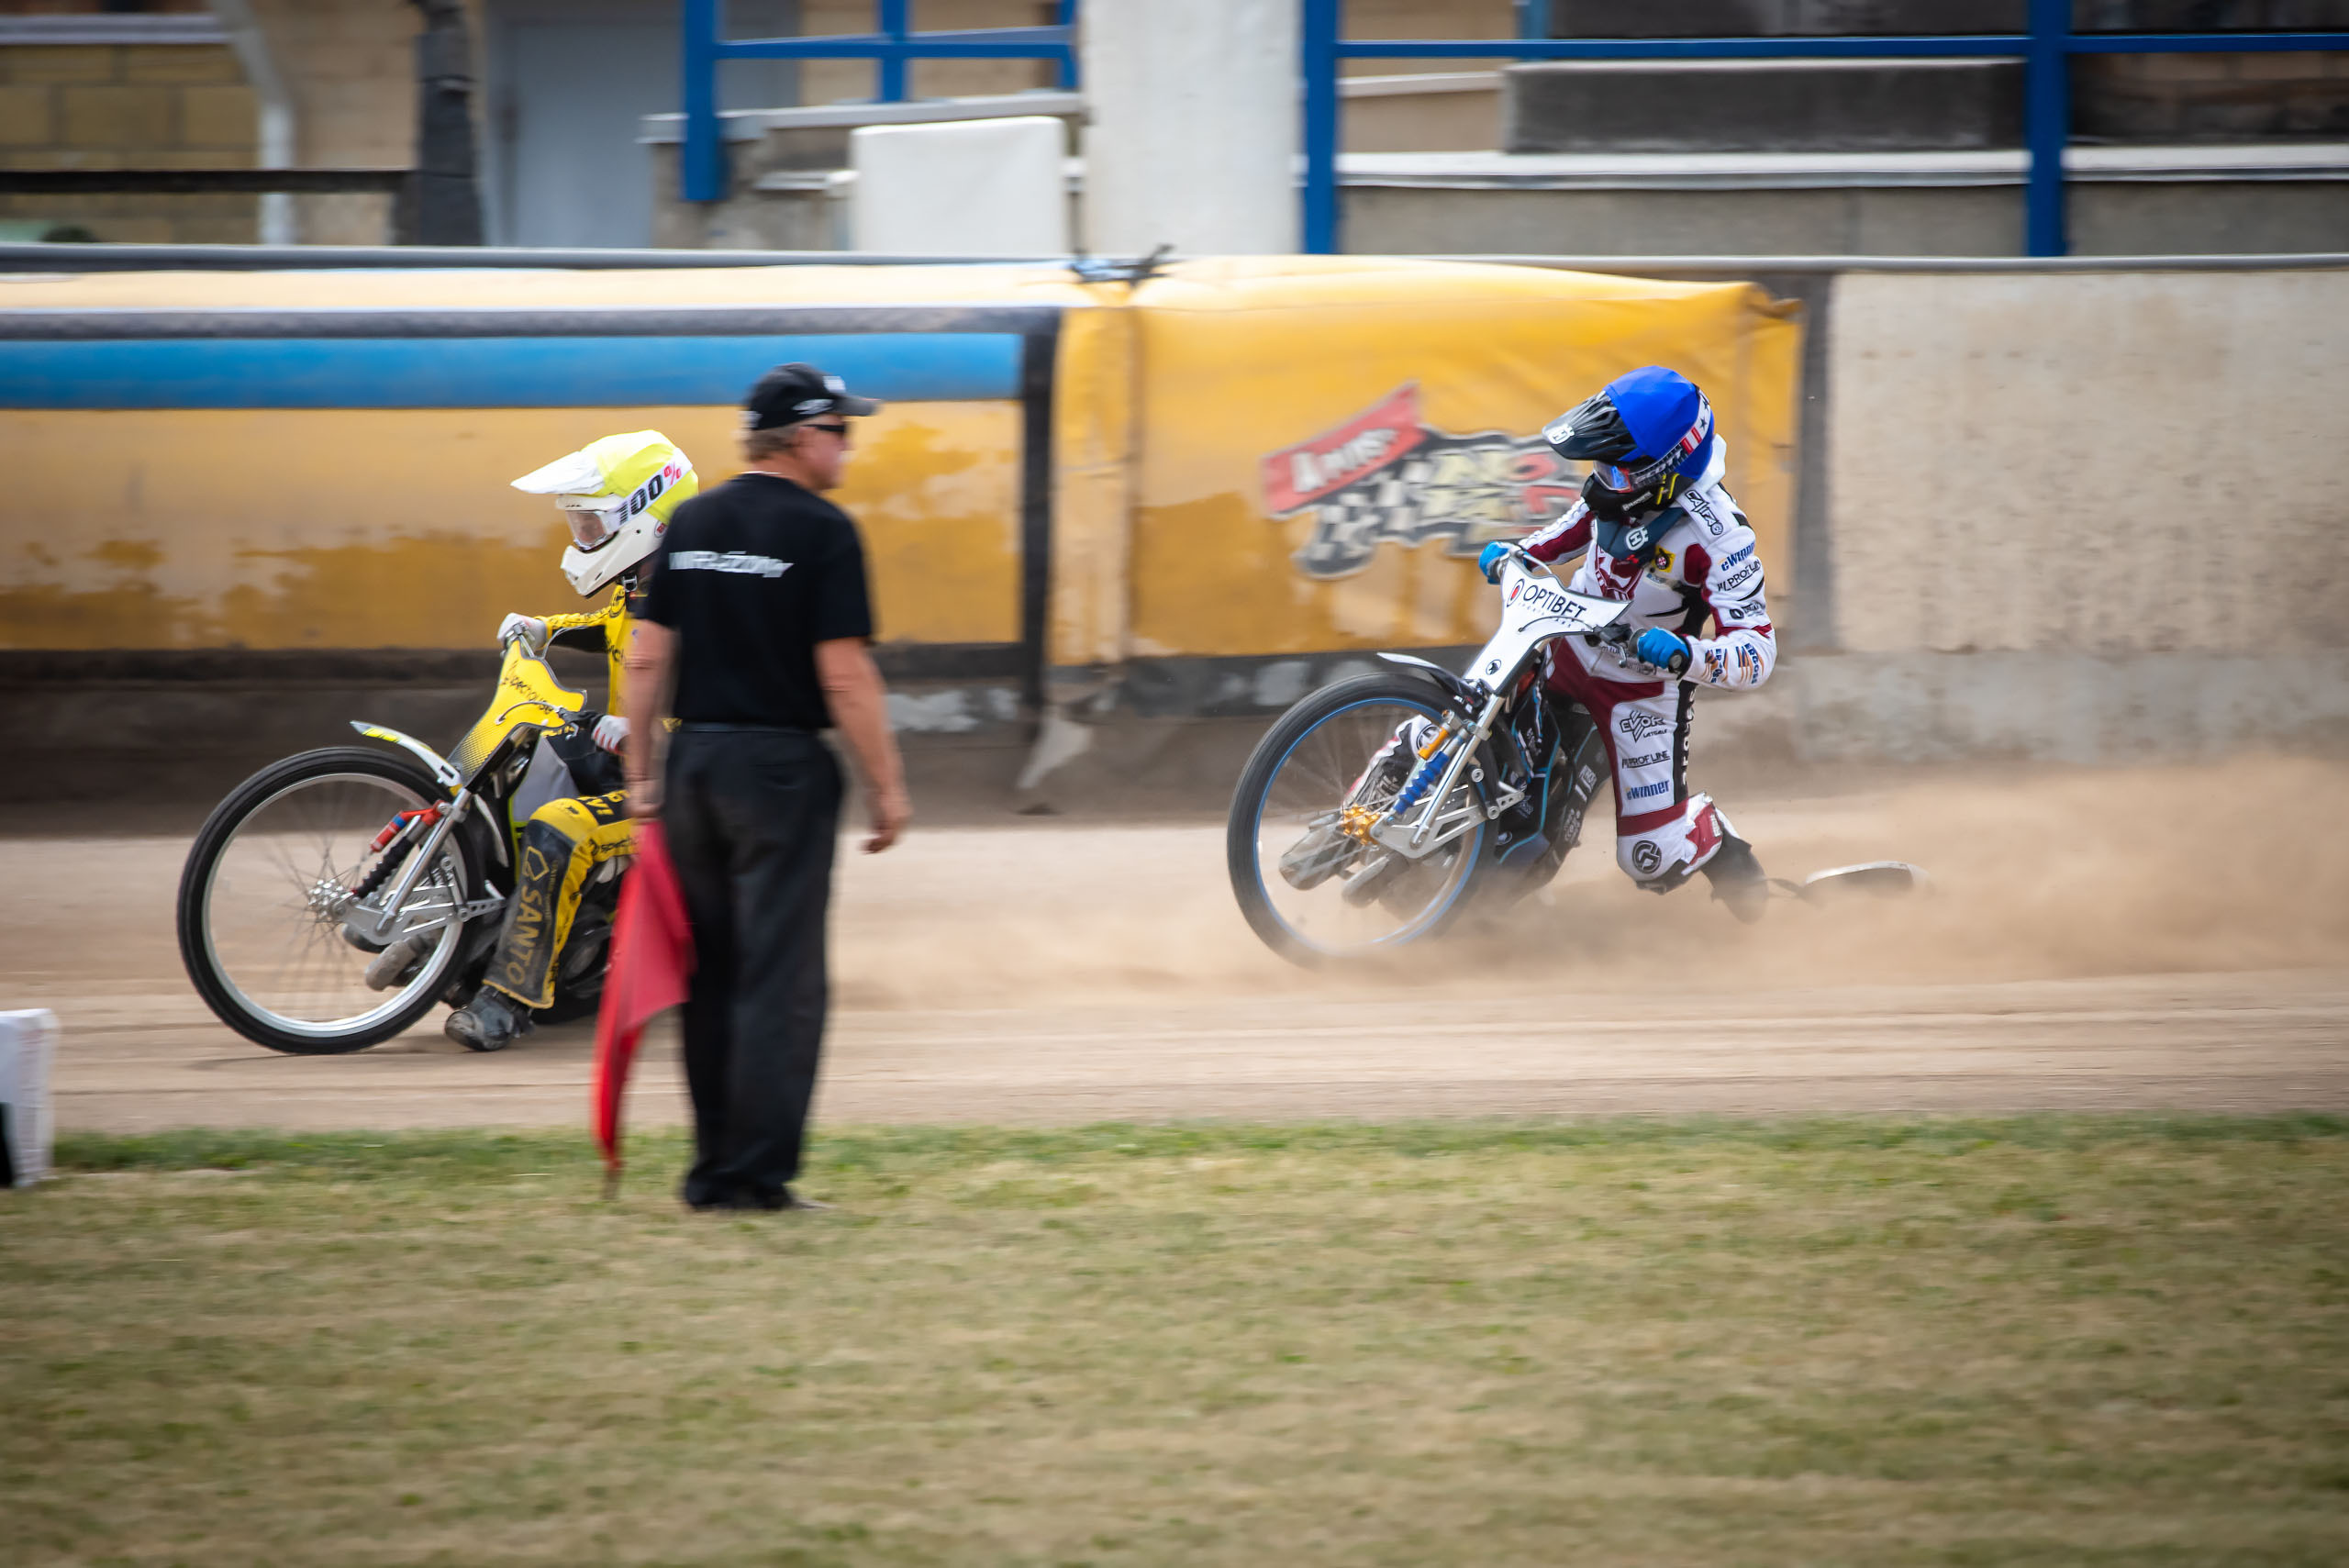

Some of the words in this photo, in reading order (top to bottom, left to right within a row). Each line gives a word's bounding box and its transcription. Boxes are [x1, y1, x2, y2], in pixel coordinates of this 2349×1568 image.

[616, 462, 683, 526] 100%
[1523, 584, 1587, 618] OPTIBET
[506, 884, 543, 986] SANTO
